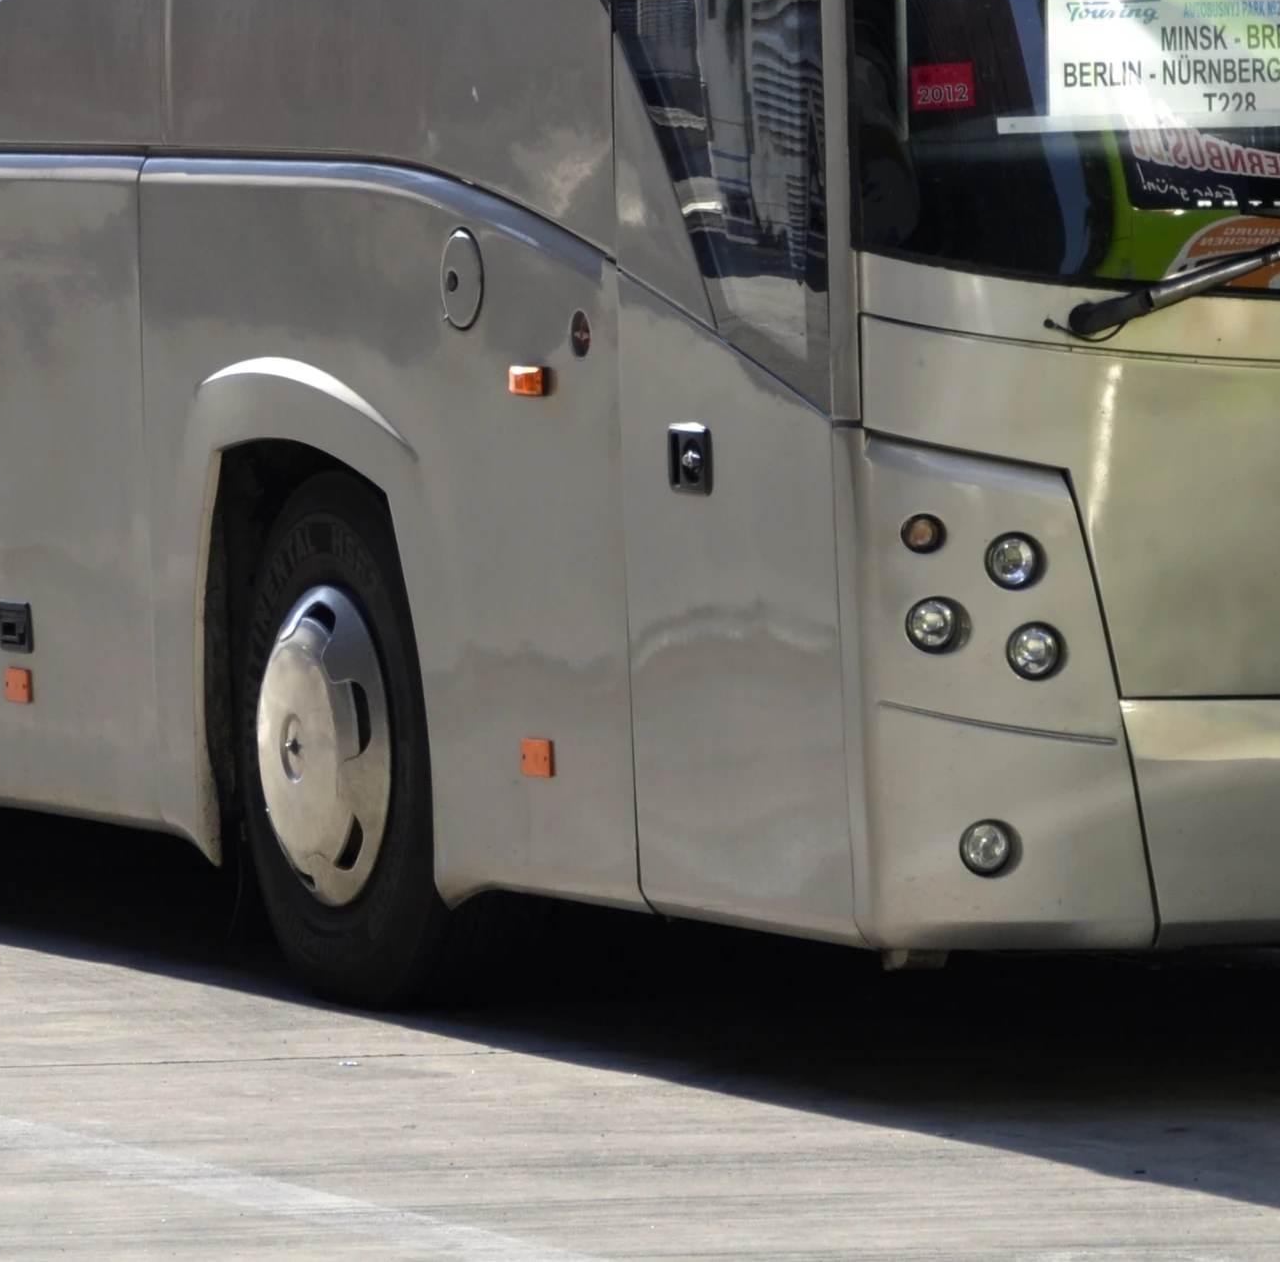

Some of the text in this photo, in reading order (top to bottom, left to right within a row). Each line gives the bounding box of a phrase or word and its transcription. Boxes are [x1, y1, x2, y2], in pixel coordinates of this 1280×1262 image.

[1161, 25, 1228, 51] MINSK
[1063, 60, 1143, 88] BERLIN
[918, 84, 969, 105] 2012
[1203, 91, 1257, 112] T228
